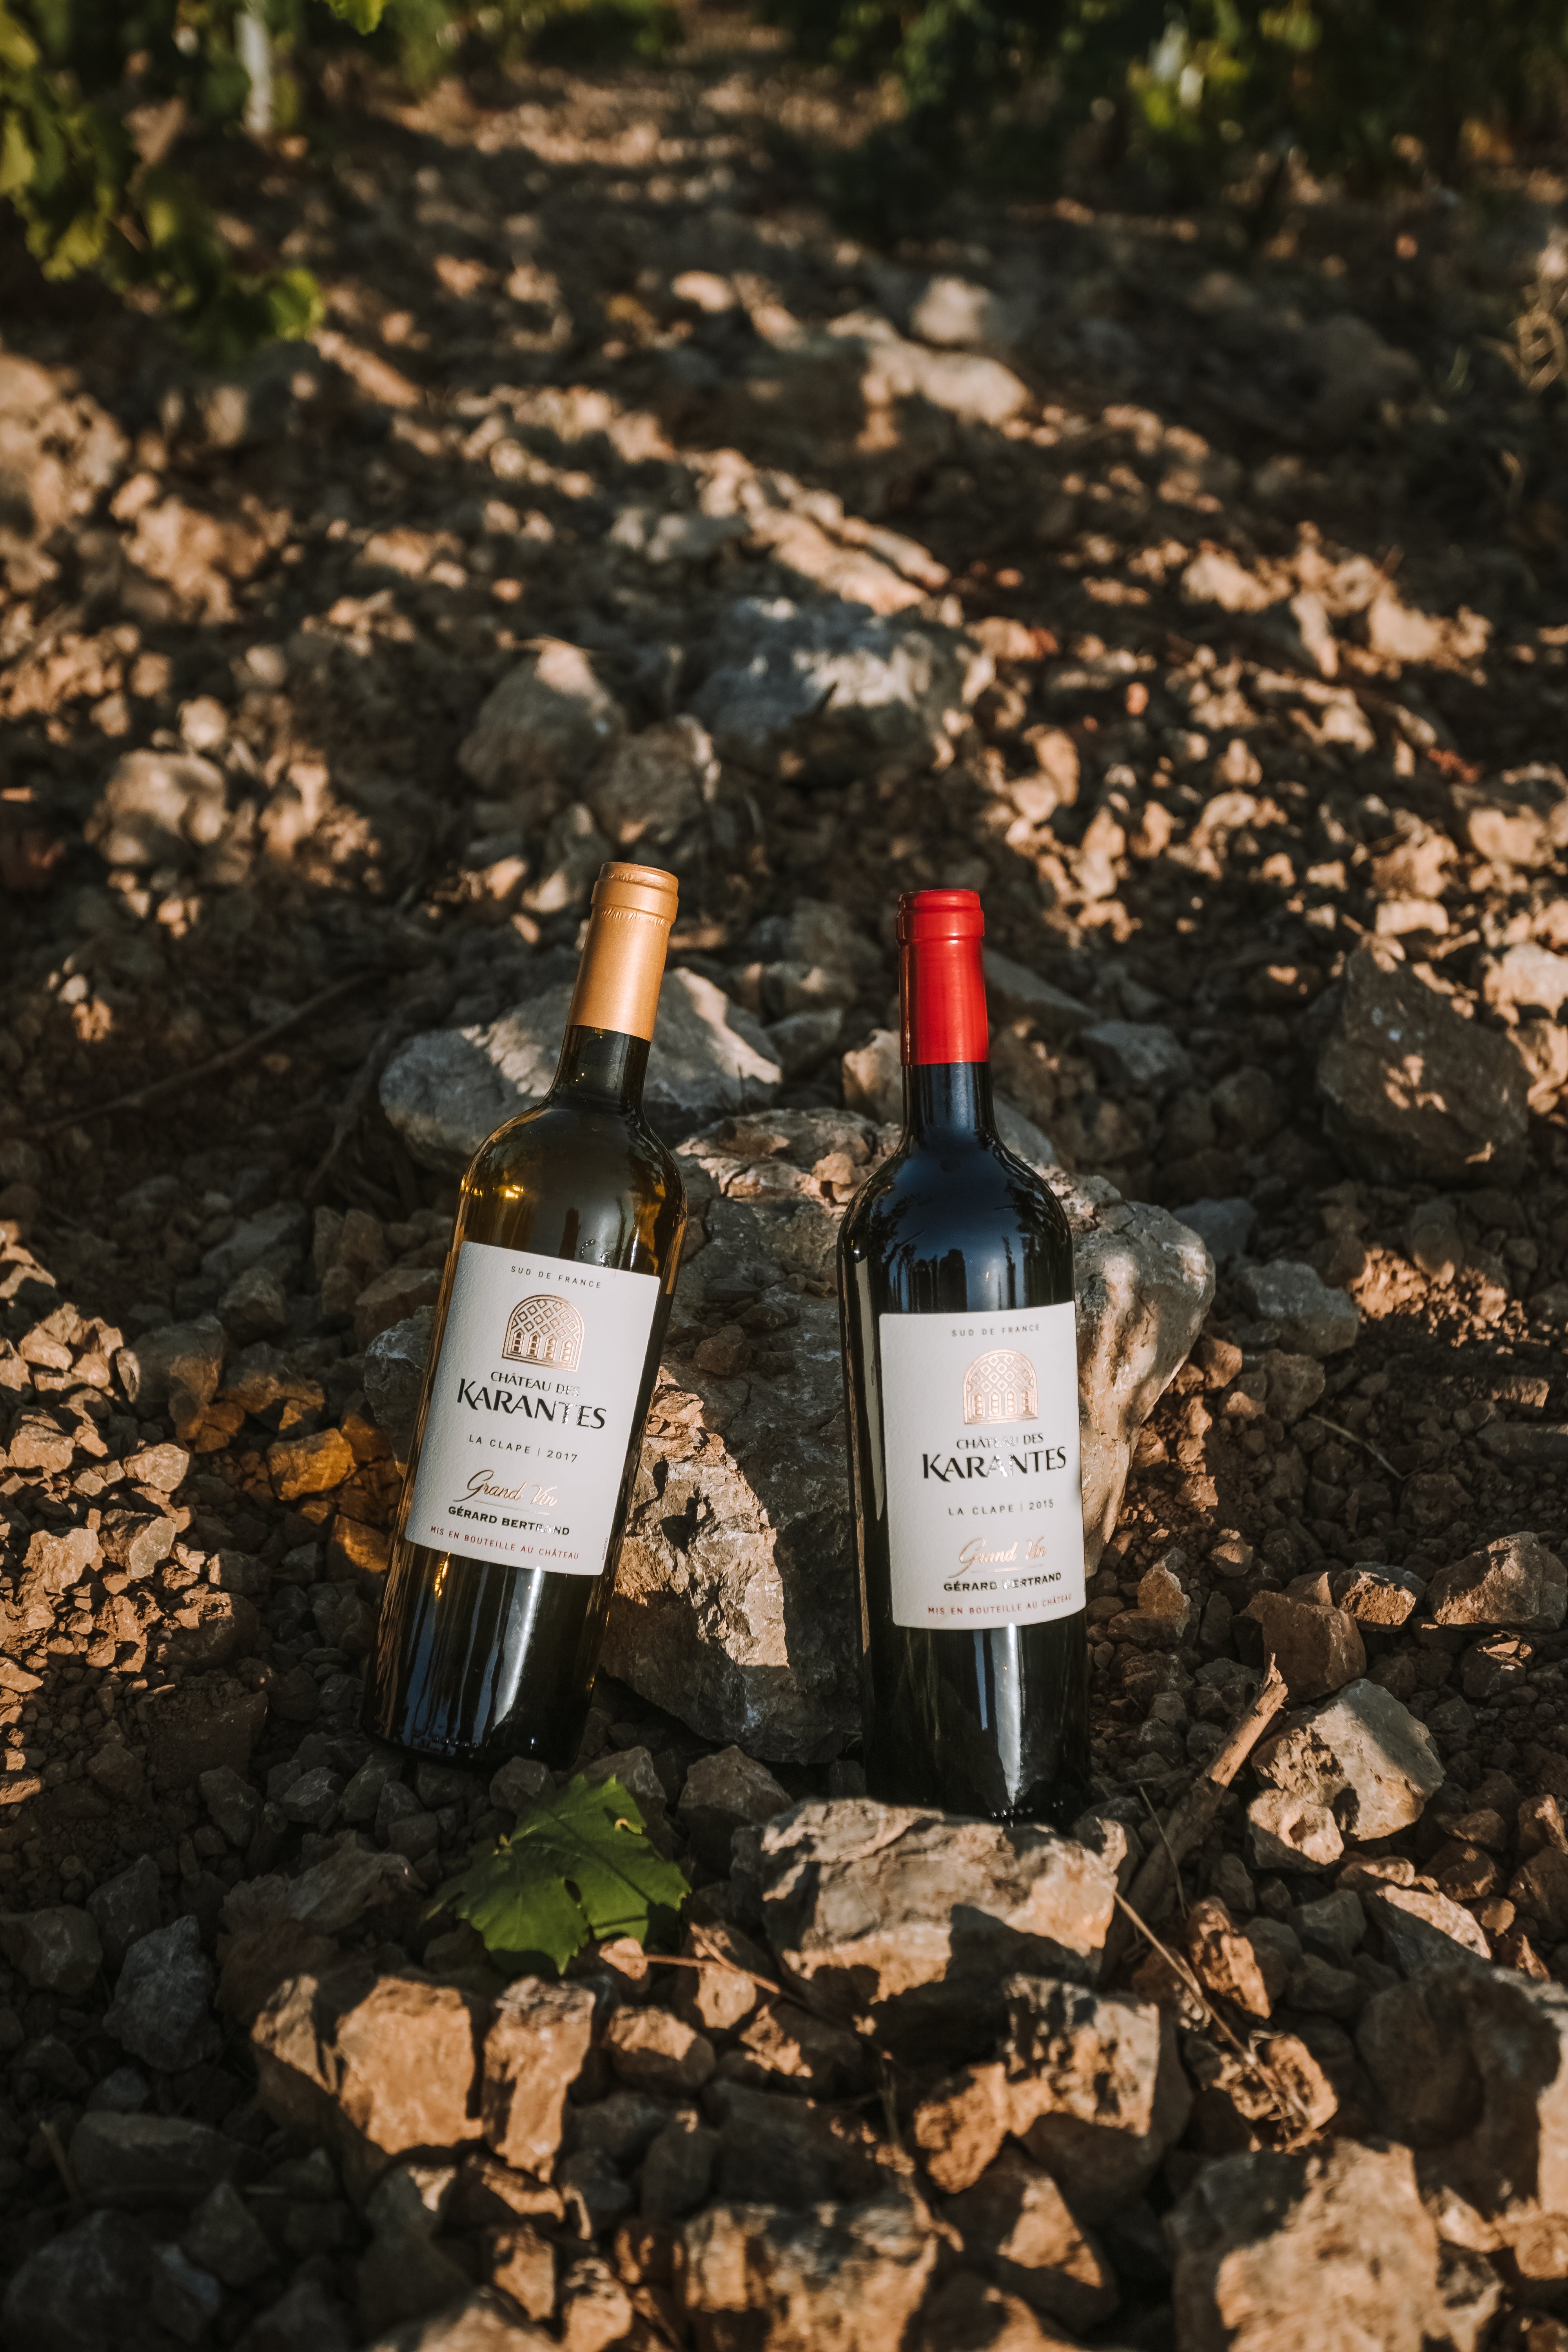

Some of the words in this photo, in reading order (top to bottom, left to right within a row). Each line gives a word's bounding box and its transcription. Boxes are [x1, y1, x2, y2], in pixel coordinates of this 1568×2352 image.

[511, 1266, 531, 1275] SUD
[558, 1275, 601, 1289] FRANCE
[1002, 1324, 1040, 1334] FRANCE
[490, 1371, 551, 1392] CHÂTEAU
[555, 1383, 580, 1396] DES
[457, 1378, 606, 1430] KARANTES
[469, 1434, 482, 1444] LA
[490, 1439, 530, 1454] CLAPE
[546, 1450, 578, 1463] 2017
[1023, 1433, 1044, 1445] DES
[922, 1446, 1067, 1483] KARANTES
[452, 1469, 527, 1502] Grand
[530, 1485, 558, 1507] Vin
[448, 1506, 497, 1524] GÉRARD
[501, 1517, 570, 1536] BERTRAND
[948, 1508, 964, 1516] LA
[972, 1504, 1014, 1515] CLAPE
[1029, 1499, 1054, 1511] 2015
[430, 1526, 444, 1535] MIS
[448, 1531, 459, 1540] EN
[464, 1535, 515, 1551] BOUTEILLE
[520, 1546, 534, 1554] AU
[539, 1548, 579, 1560] CHÂTEAU
[947, 1537, 1018, 1578] Grand
[1025, 1536, 1047, 1561] Vin
[944, 1581, 999, 1592] GÉRARD
[927, 1607, 945, 1615] MIS
[969, 1604, 1022, 1615] BOUTEILLE
[1027, 1601, 1038, 1610] AU
[1042, 1593, 1072, 1608] CHÂTEAU
